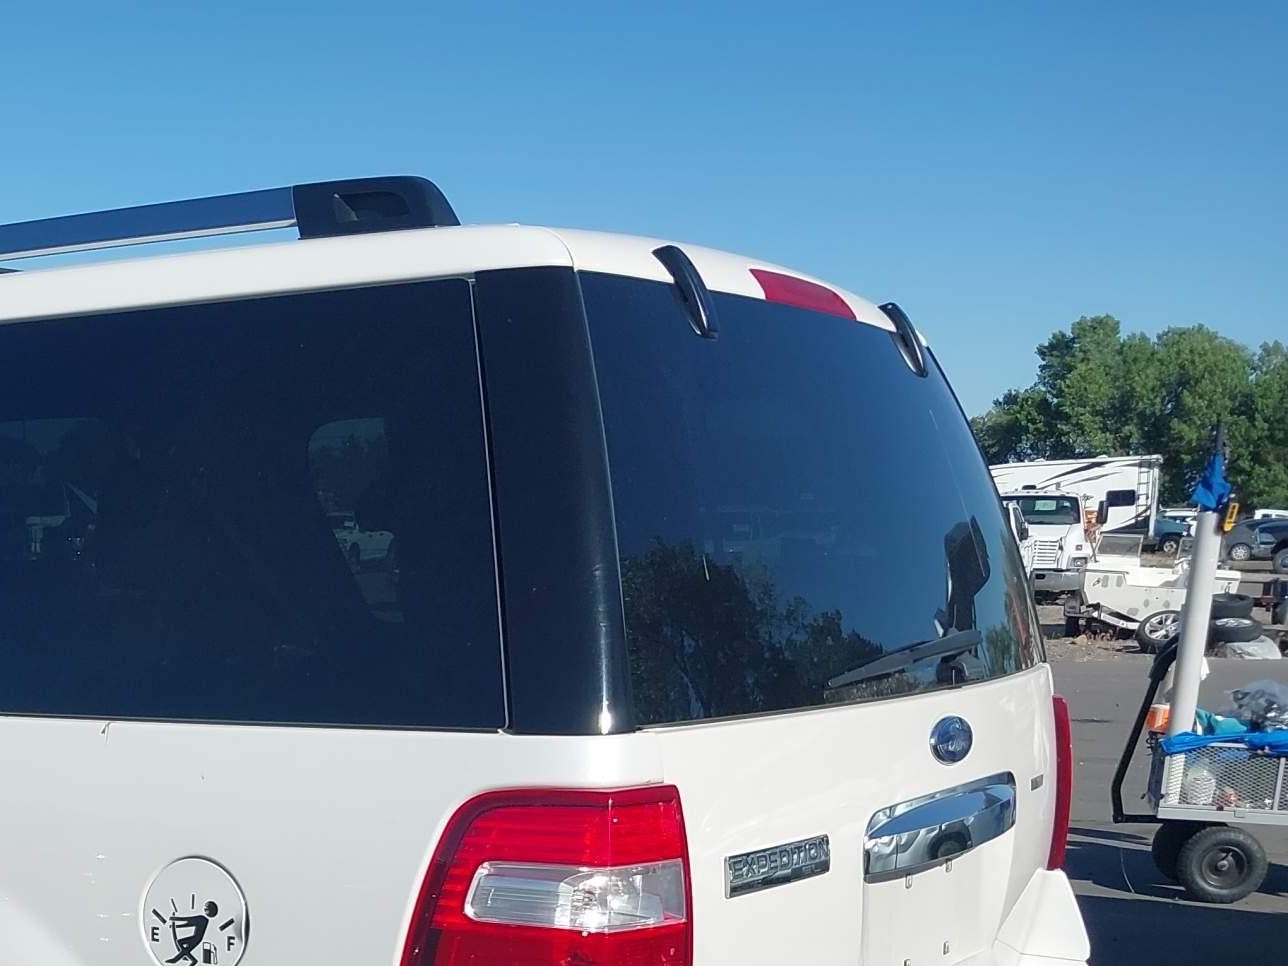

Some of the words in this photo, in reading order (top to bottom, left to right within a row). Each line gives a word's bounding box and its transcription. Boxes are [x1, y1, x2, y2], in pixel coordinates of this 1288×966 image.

[729, 837, 828, 881] EXPEDITION
[151, 926, 160, 942] E
[226, 936, 236, 951] F
